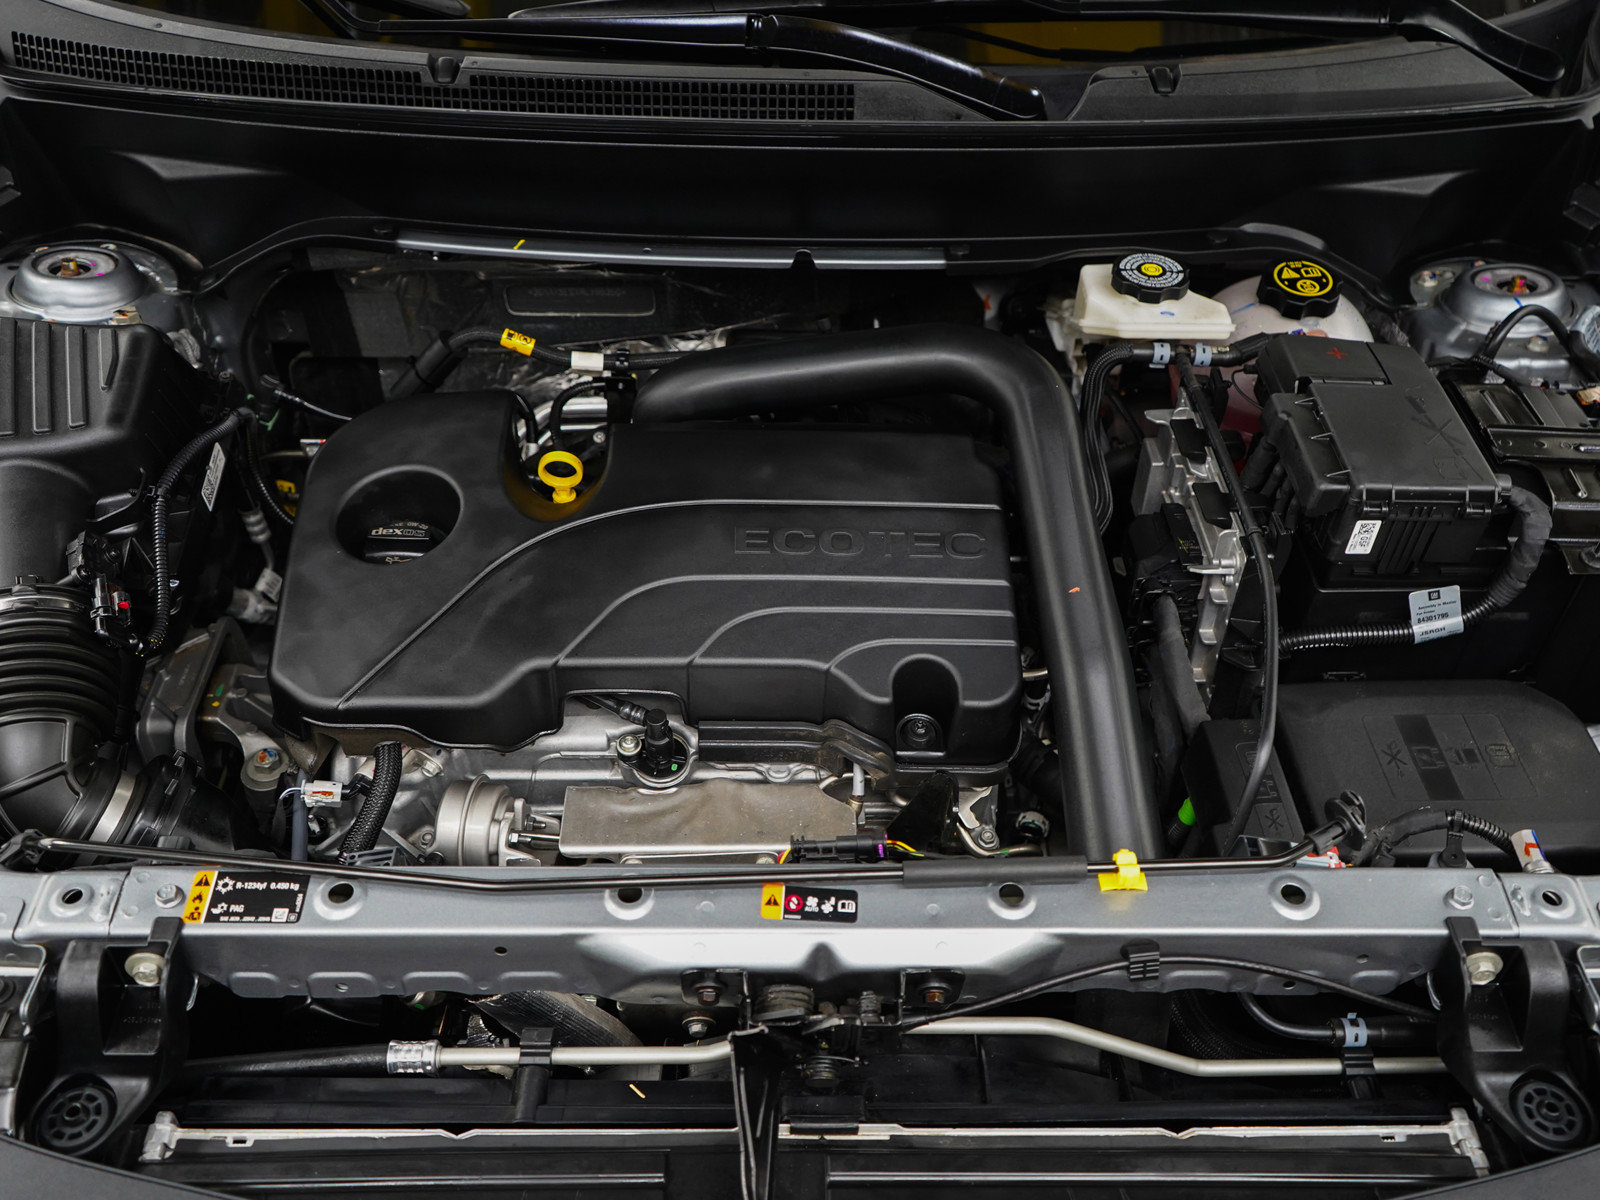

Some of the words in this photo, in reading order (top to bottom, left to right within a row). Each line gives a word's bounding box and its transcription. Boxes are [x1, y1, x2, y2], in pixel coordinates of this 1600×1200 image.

[371, 527, 426, 537] dexos
[734, 526, 986, 560] ECOTEC
[235, 881, 268, 891] R-1234yf
[289, 881, 300, 891] kg
[229, 904, 245, 913] PAG
